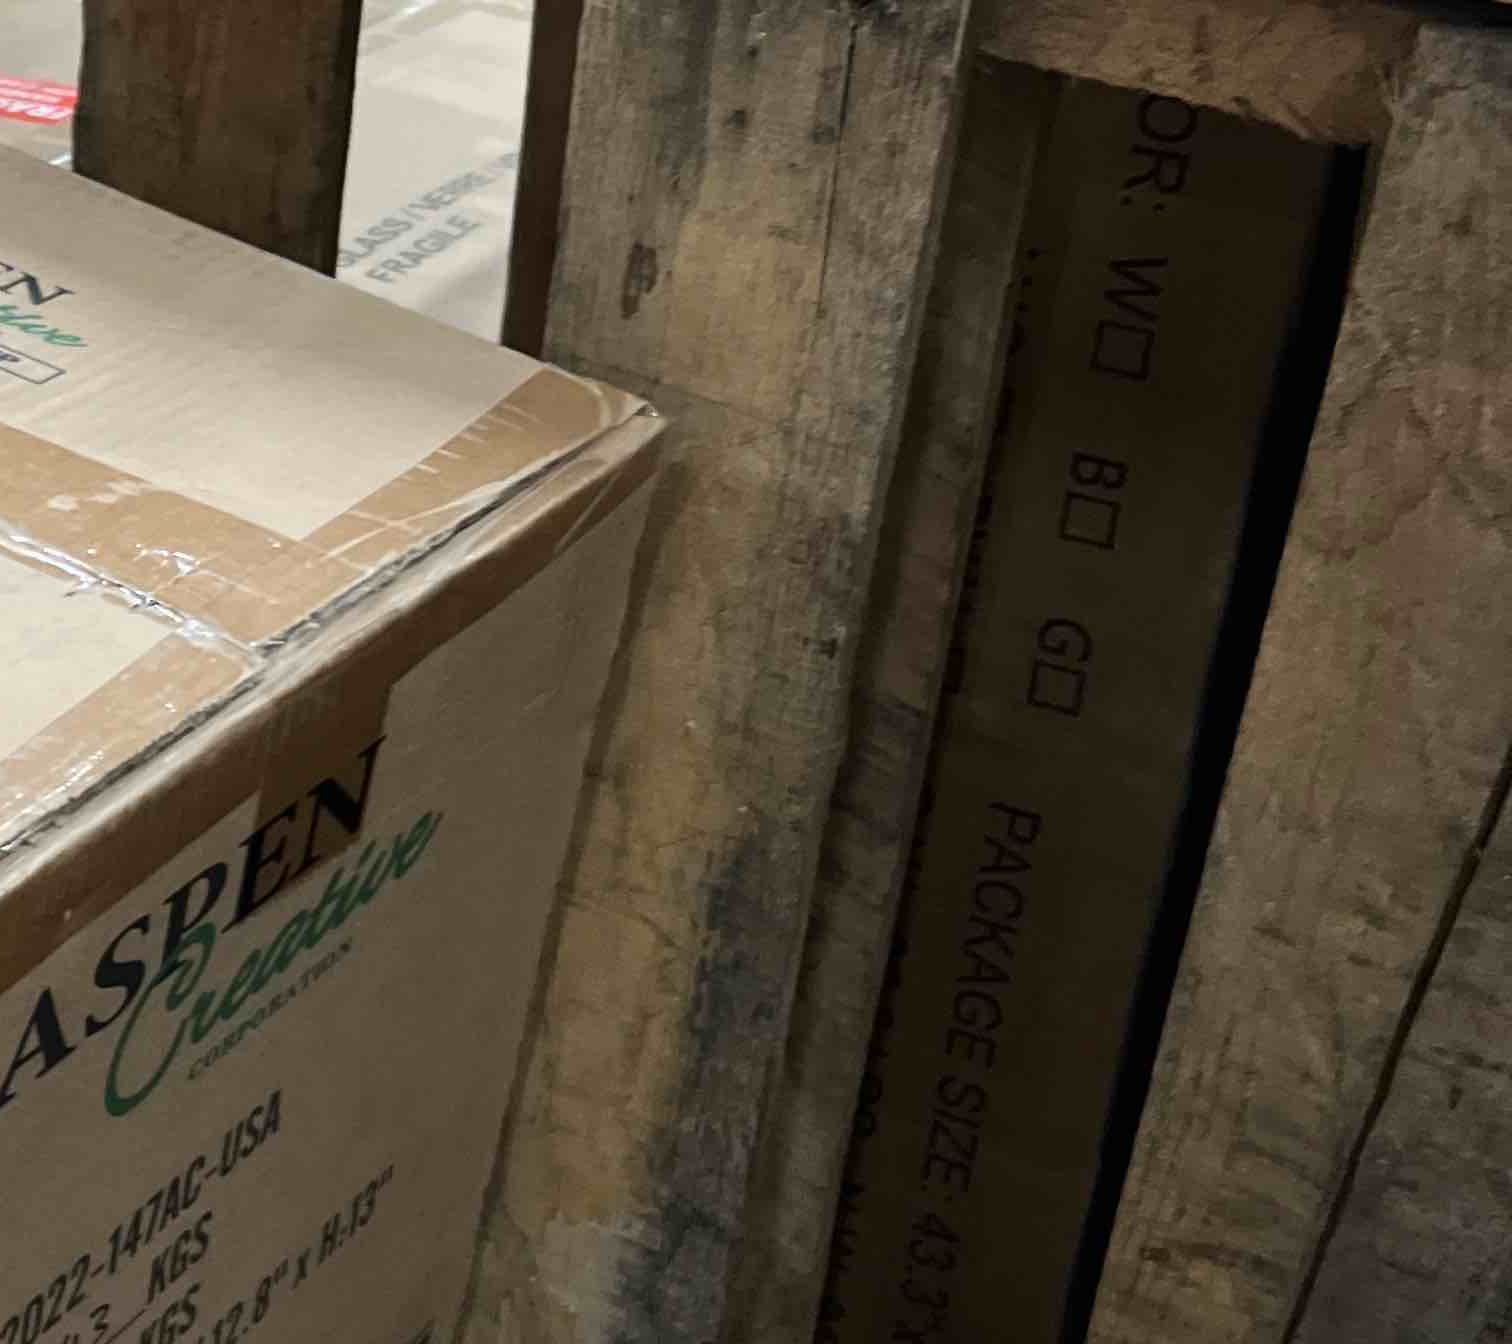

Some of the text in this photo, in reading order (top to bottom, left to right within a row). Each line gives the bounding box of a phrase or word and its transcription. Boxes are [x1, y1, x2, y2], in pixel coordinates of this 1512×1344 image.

[364, 214, 482, 283] FRAGILE
[104, 810, 443, 1117] Creative
[944, 799, 1044, 1072] PACKAGE
[187, 936, 353, 1082] CORPORATION
[146, 1210, 213, 1306] KGS
